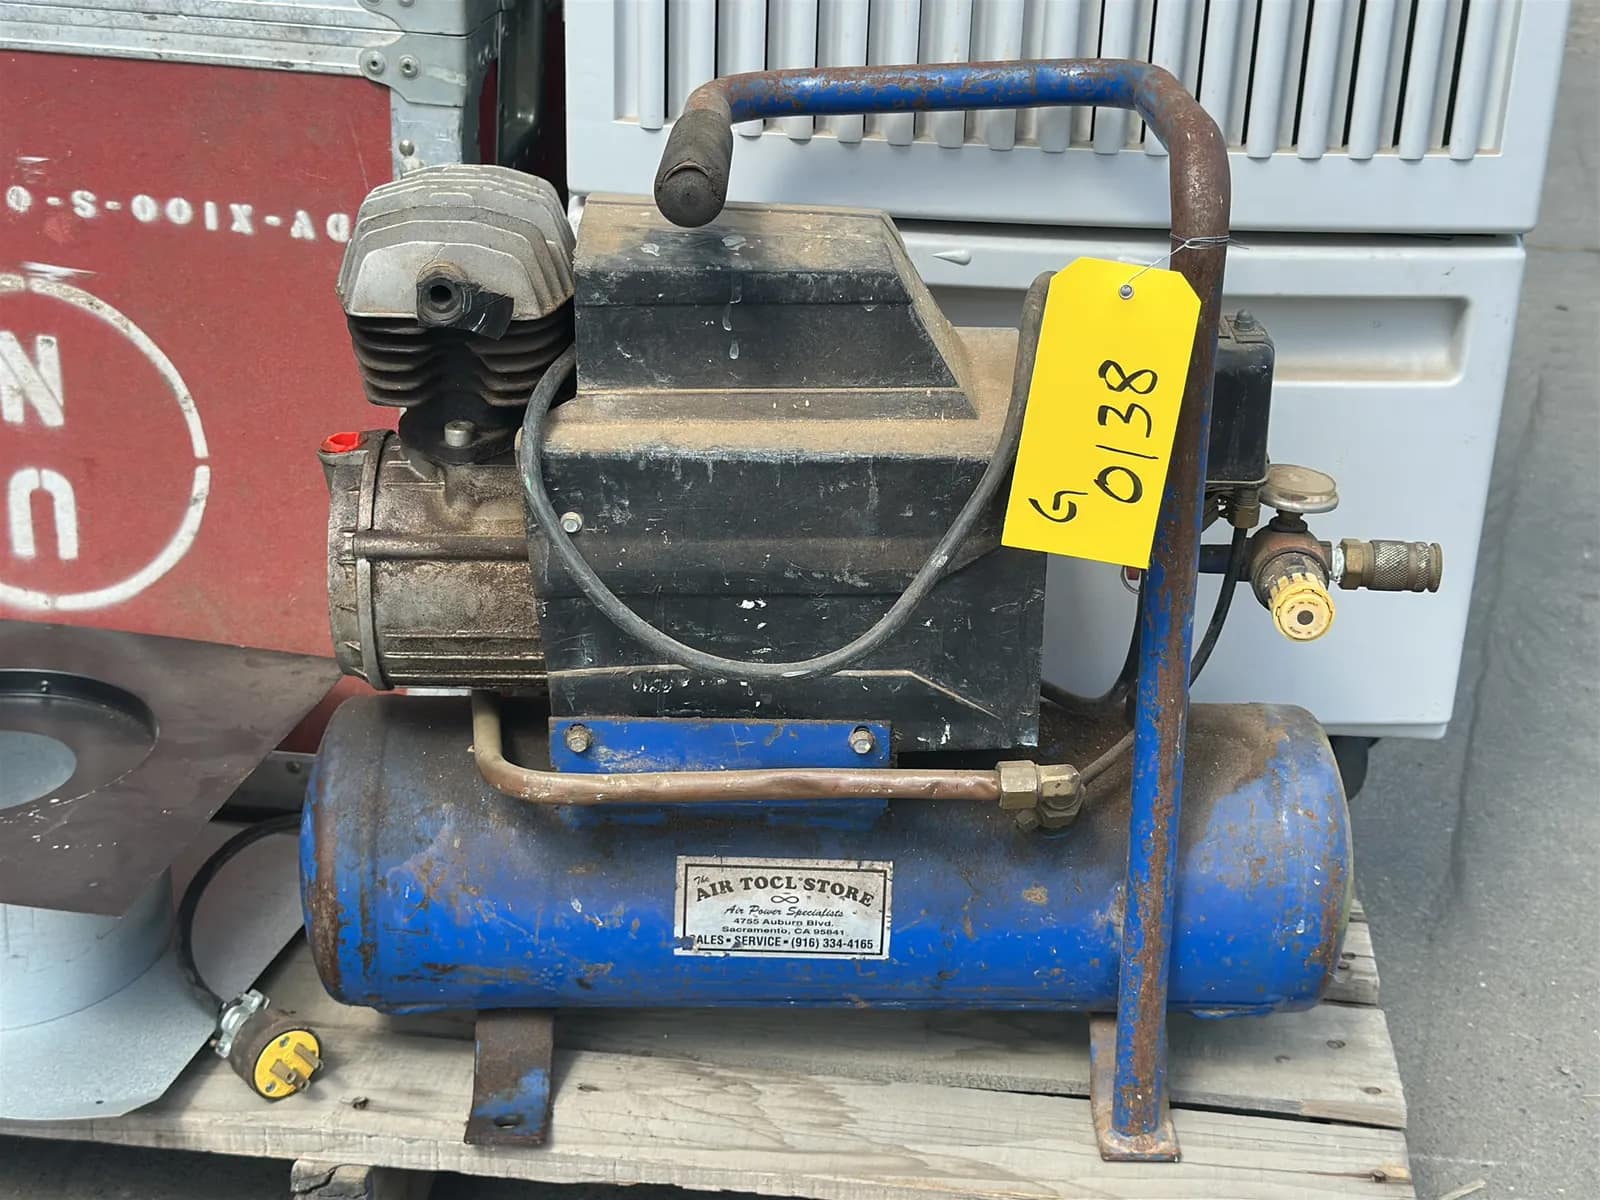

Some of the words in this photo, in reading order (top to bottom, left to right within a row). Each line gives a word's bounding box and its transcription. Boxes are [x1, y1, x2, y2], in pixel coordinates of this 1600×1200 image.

[696, 879, 735, 902] AIR
[803, 876, 875, 908] STORE
[723, 904, 744, 915] Air
[748, 904, 782, 916] Power
[786, 906, 844, 918] Specialists
[762, 918, 803, 927] Auburn
[806, 919, 834, 928] Blvd.
[721, 926, 791, 936] Sacramento,
[794, 927, 811, 936] CA
[690, 934, 724, 945] ALES
[734, 935, 781, 947] SERVICE
[790, 937, 820, 950] (916)
[823, 937, 874, 950] 334-4165
